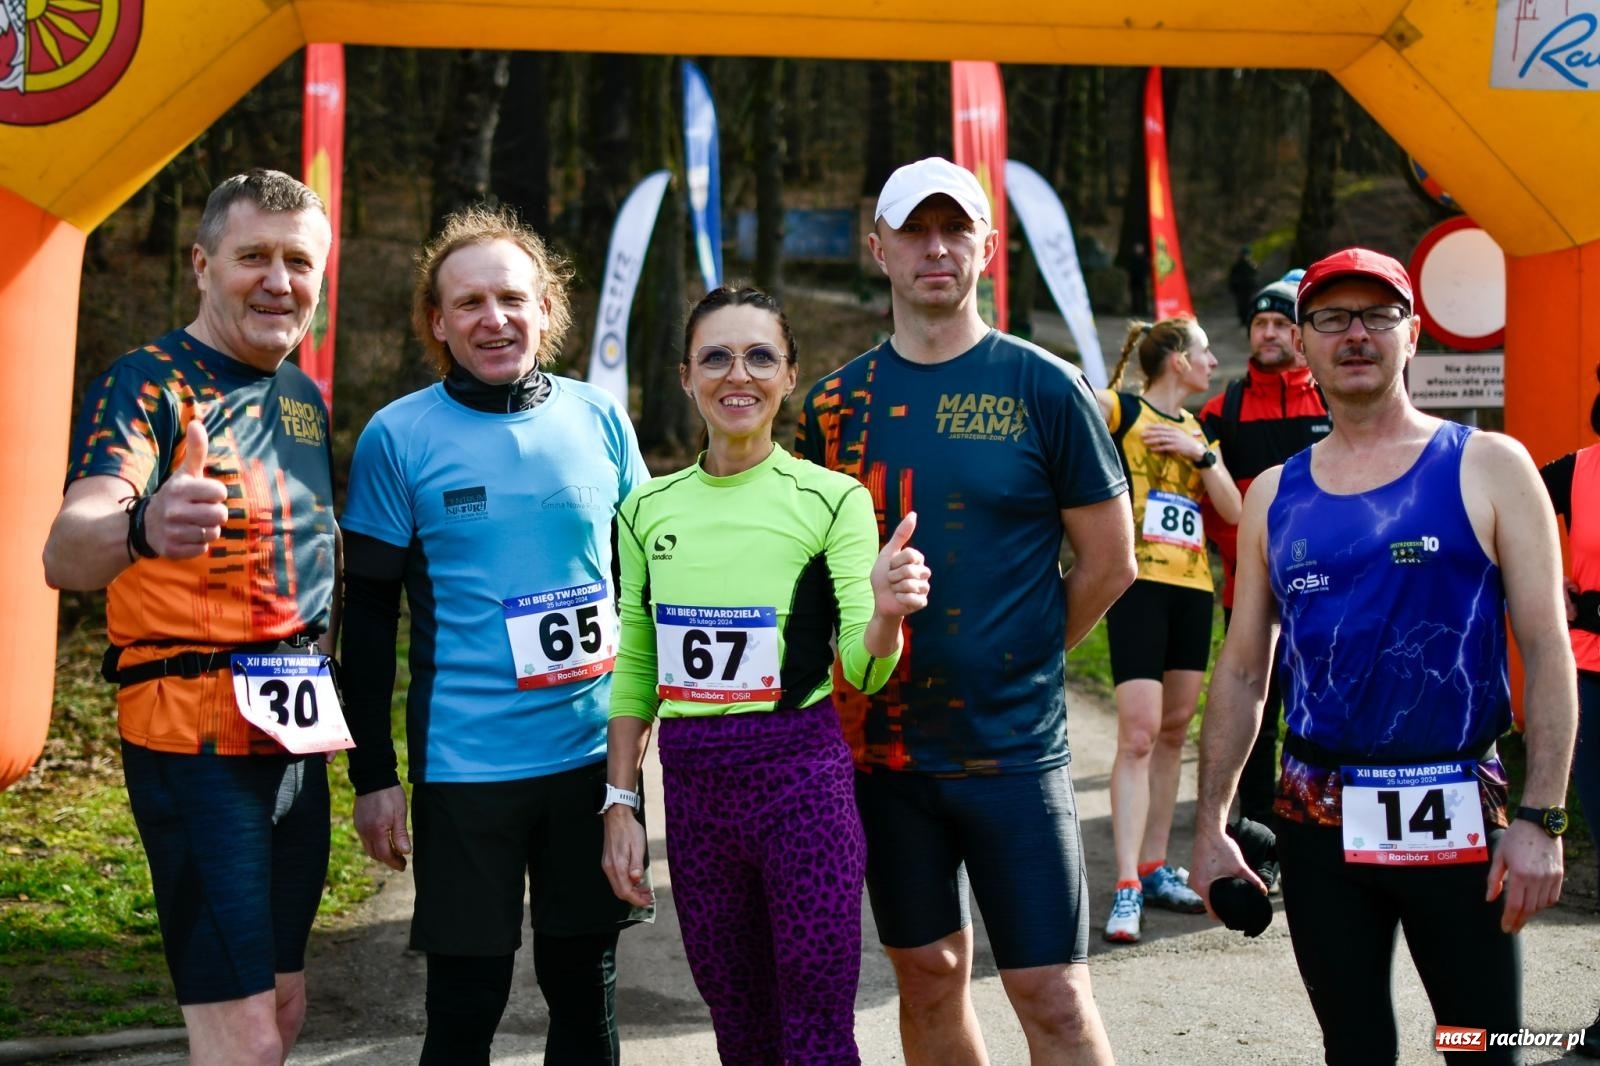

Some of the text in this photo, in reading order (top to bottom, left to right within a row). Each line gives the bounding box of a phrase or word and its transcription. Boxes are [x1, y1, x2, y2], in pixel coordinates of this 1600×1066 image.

[1519, 12, 1600, 88] Ra
[279, 396, 314, 422] MARO
[937, 393, 1015, 416] MARO
[281, 416, 320, 441] TEAM
[936, 413, 1011, 435] TEAM
[1161, 505, 1195, 536] 86
[1422, 536, 1439, 551] 10
[652, 553, 673, 561] Sondico
[518, 598, 531, 608] XII
[532, 594, 554, 605] BIEG
[555, 598, 574, 608] lutego
[666, 607, 761, 619] XII BIEG TWARDZIELA
[697, 618, 716, 627] lutego
[539, 605, 602, 662] 65
[247, 657, 259, 667] XII
[261, 657, 282, 667] BIEG
[682, 629, 747, 681] 67
[282, 666, 298, 675] lutego
[557, 668, 588, 680] Racibórz
[691, 690, 751, 700] Racibórz OSiR
[259, 679, 318, 728] 30
[1357, 764, 1462, 778] XII BIEG TWARDZIELA
[1397, 777, 1419, 786] lutego
[1420, 776, 1436, 784] 2024
[1377, 788, 1451, 841] 14
[1388, 851, 1457, 861] Racibórz OSiR
